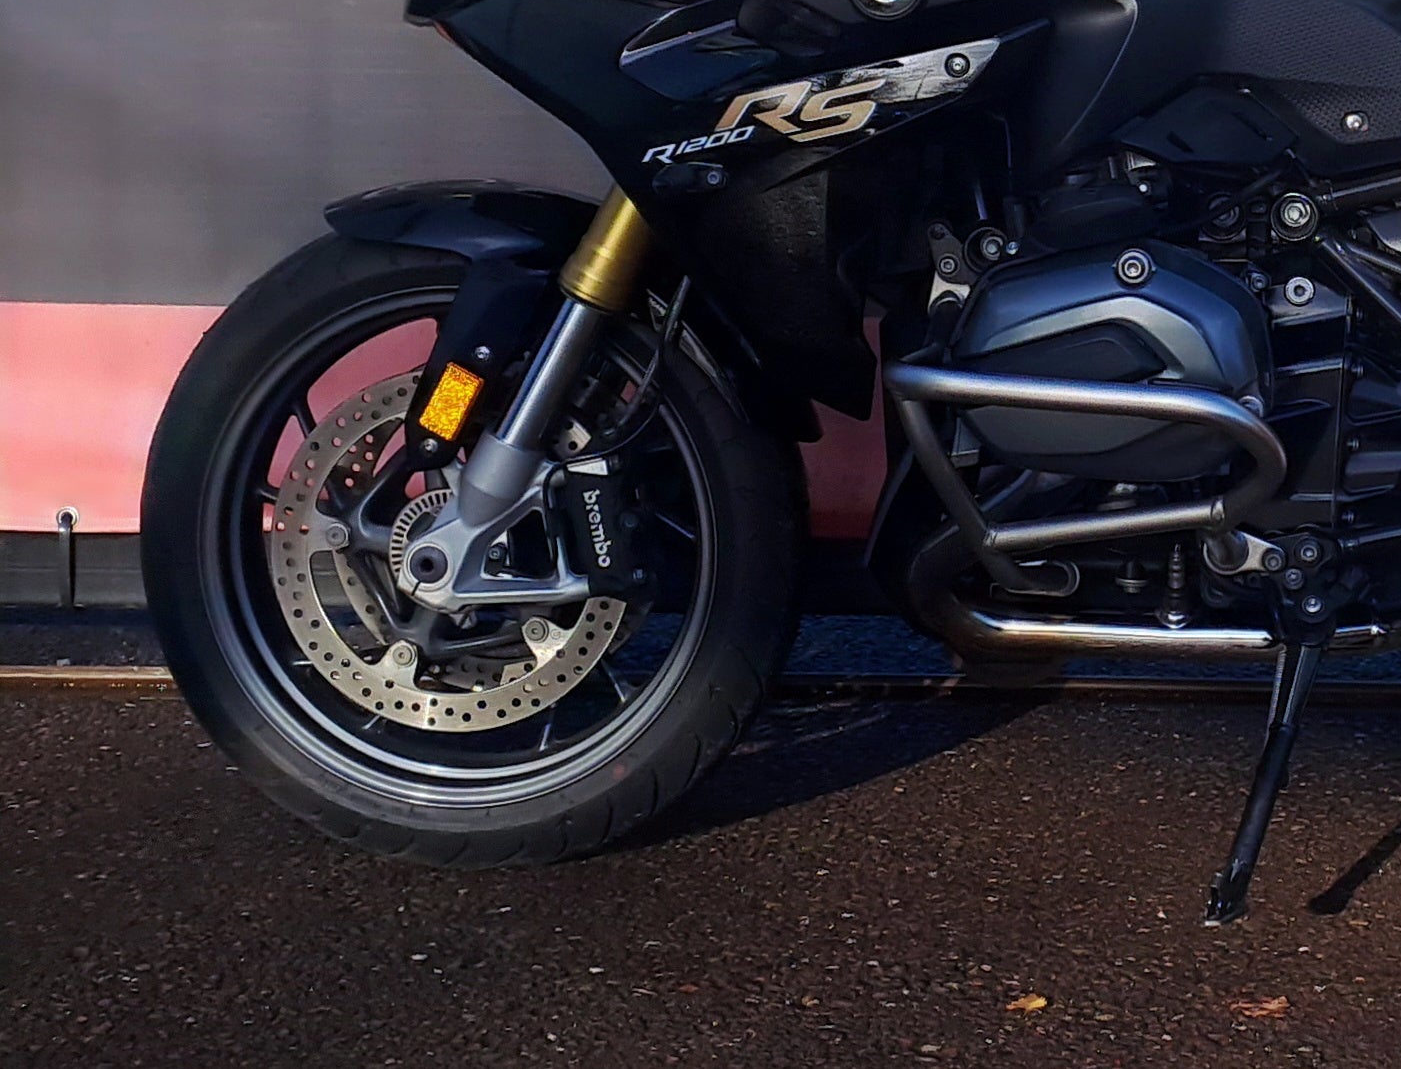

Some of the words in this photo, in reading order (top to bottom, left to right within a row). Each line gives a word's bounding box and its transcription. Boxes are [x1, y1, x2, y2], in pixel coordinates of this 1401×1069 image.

[641, 125, 755, 164] R1200
[714, 80, 887, 143] RS
[582, 489, 612, 568] brembo
